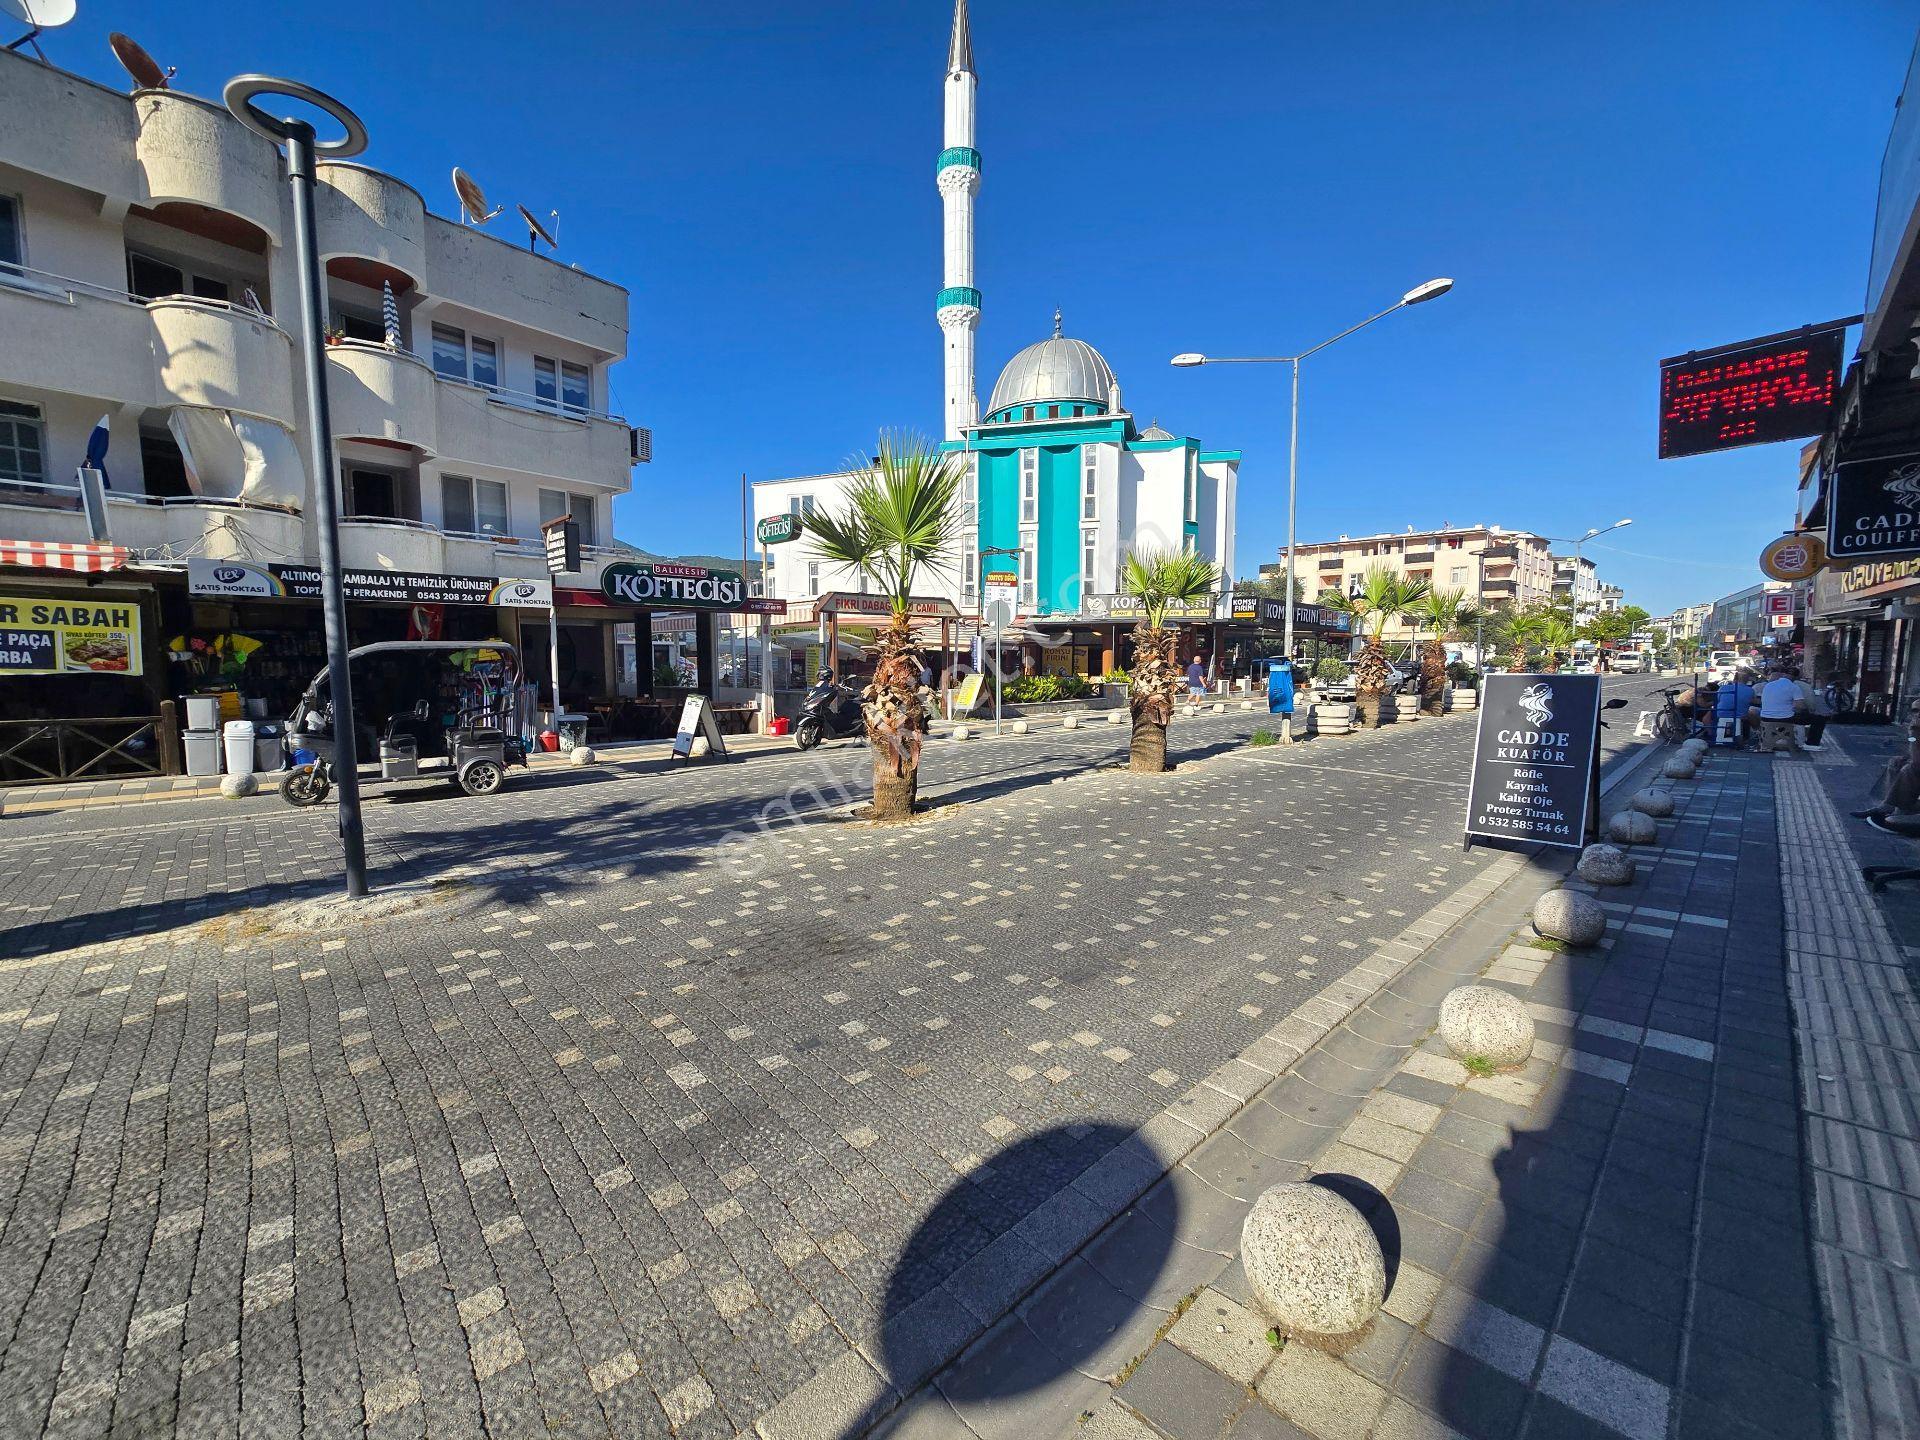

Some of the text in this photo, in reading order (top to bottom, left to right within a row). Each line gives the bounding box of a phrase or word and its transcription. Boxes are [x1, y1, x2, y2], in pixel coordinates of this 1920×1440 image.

[1855, 513, 1920, 531] CAD
[655, 565, 707, 576] BALIKESİR
[194, 583, 265, 593] SATIŞ NOKTASI
[280, 570, 493, 591] ALTINO AMBALAJ VE TEMİZLİK ÜRÜNLERİ
[613, 569, 742, 604] KÖFTECİSİ
[294, 586, 323, 595] TOPT
[353, 588, 408, 599] PERAKENDE
[417, 591, 440, 600] 0543
[443, 593, 459, 601] 208
[462, 593, 473, 601] 26
[475, 594, 486, 602] 07
[1772, 597, 1787, 611] E
[31, 605, 130, 628] SABAH
[1778, 616, 1789, 625] E
[8, 633, 52, 650] PAÇA
[1497, 730, 1570, 747] CADDE
[1497, 747, 1565, 762] KUAFÖR
[1513, 768, 1543, 779] Röfle
[1506, 781, 1549, 793] Kaynak
[1499, 792, 1553, 807] Kalıcı Oje
[1486, 803, 1564, 821] Protez Tırnak
[1478, 816, 1570, 835] 0 532 585 54 64
